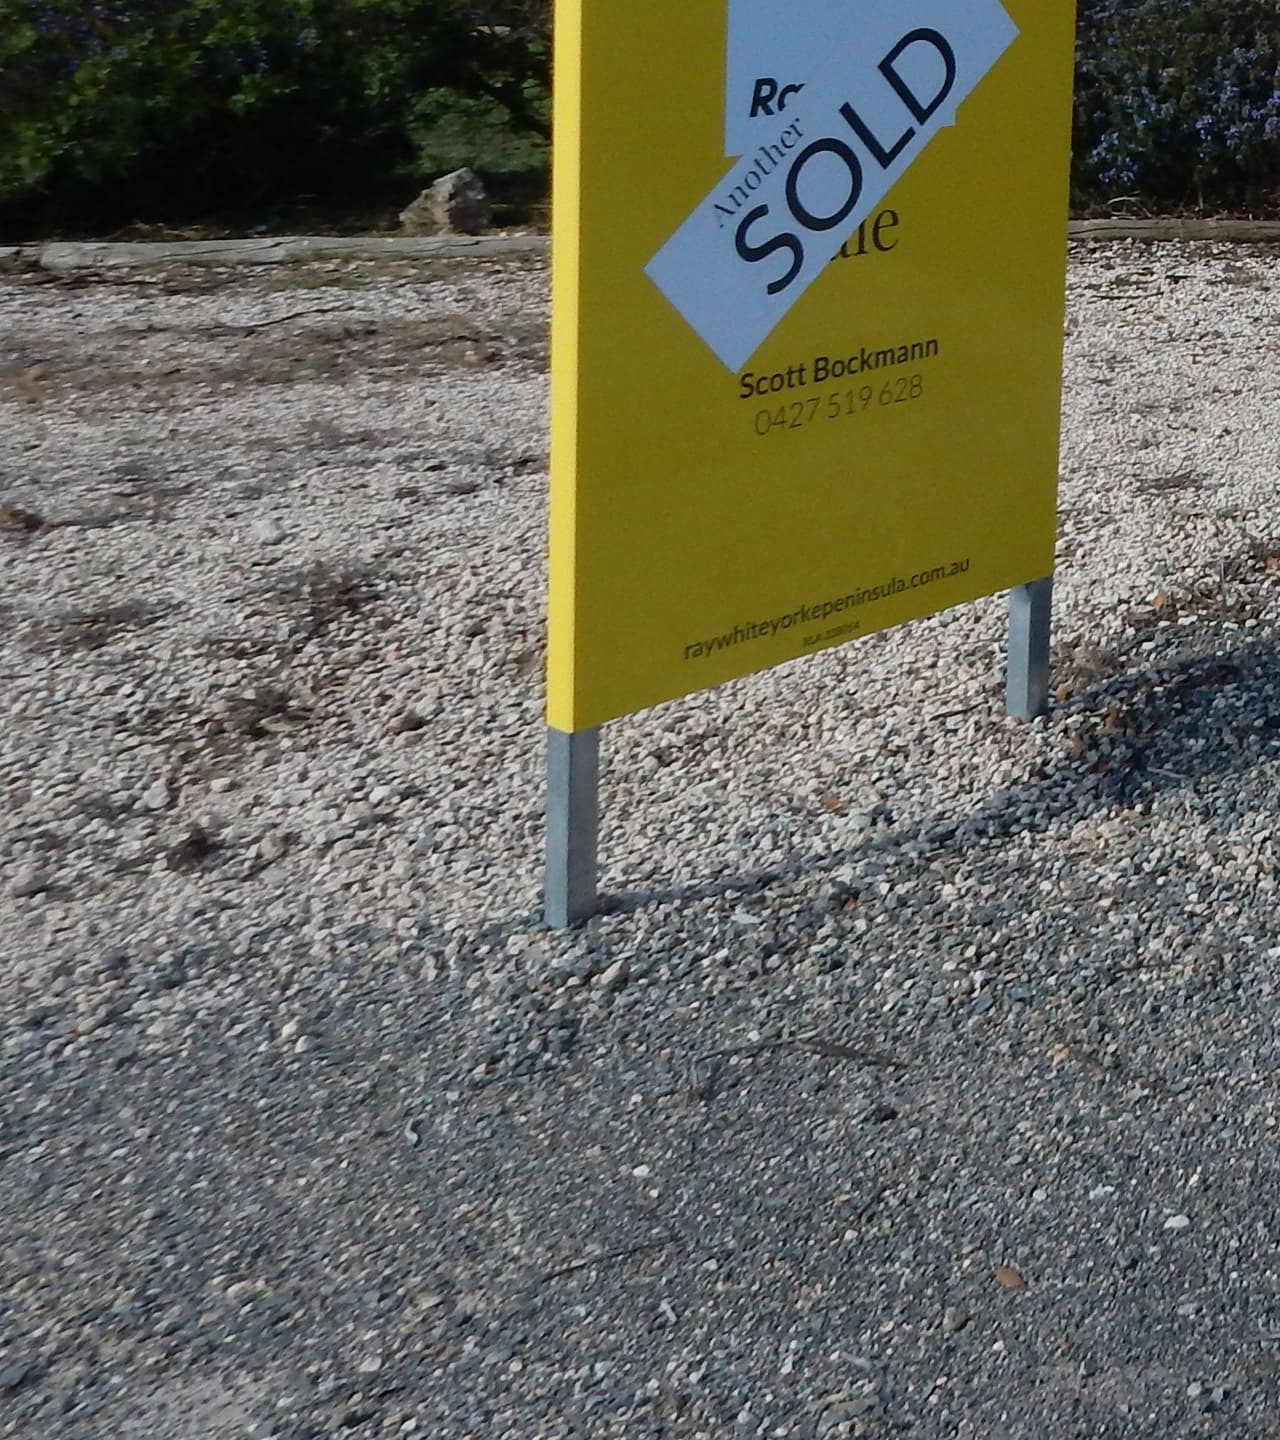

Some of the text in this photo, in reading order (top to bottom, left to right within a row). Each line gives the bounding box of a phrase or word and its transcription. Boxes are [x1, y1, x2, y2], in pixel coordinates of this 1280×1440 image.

[714, 117, 804, 228] Another
[735, 27, 957, 295] SOLD
[739, 338, 939, 399] Scott Bockmann
[754, 373, 924, 436] 0427 519 628
[684, 558, 971, 659] raywhiteyorkepeninsula.com.au
